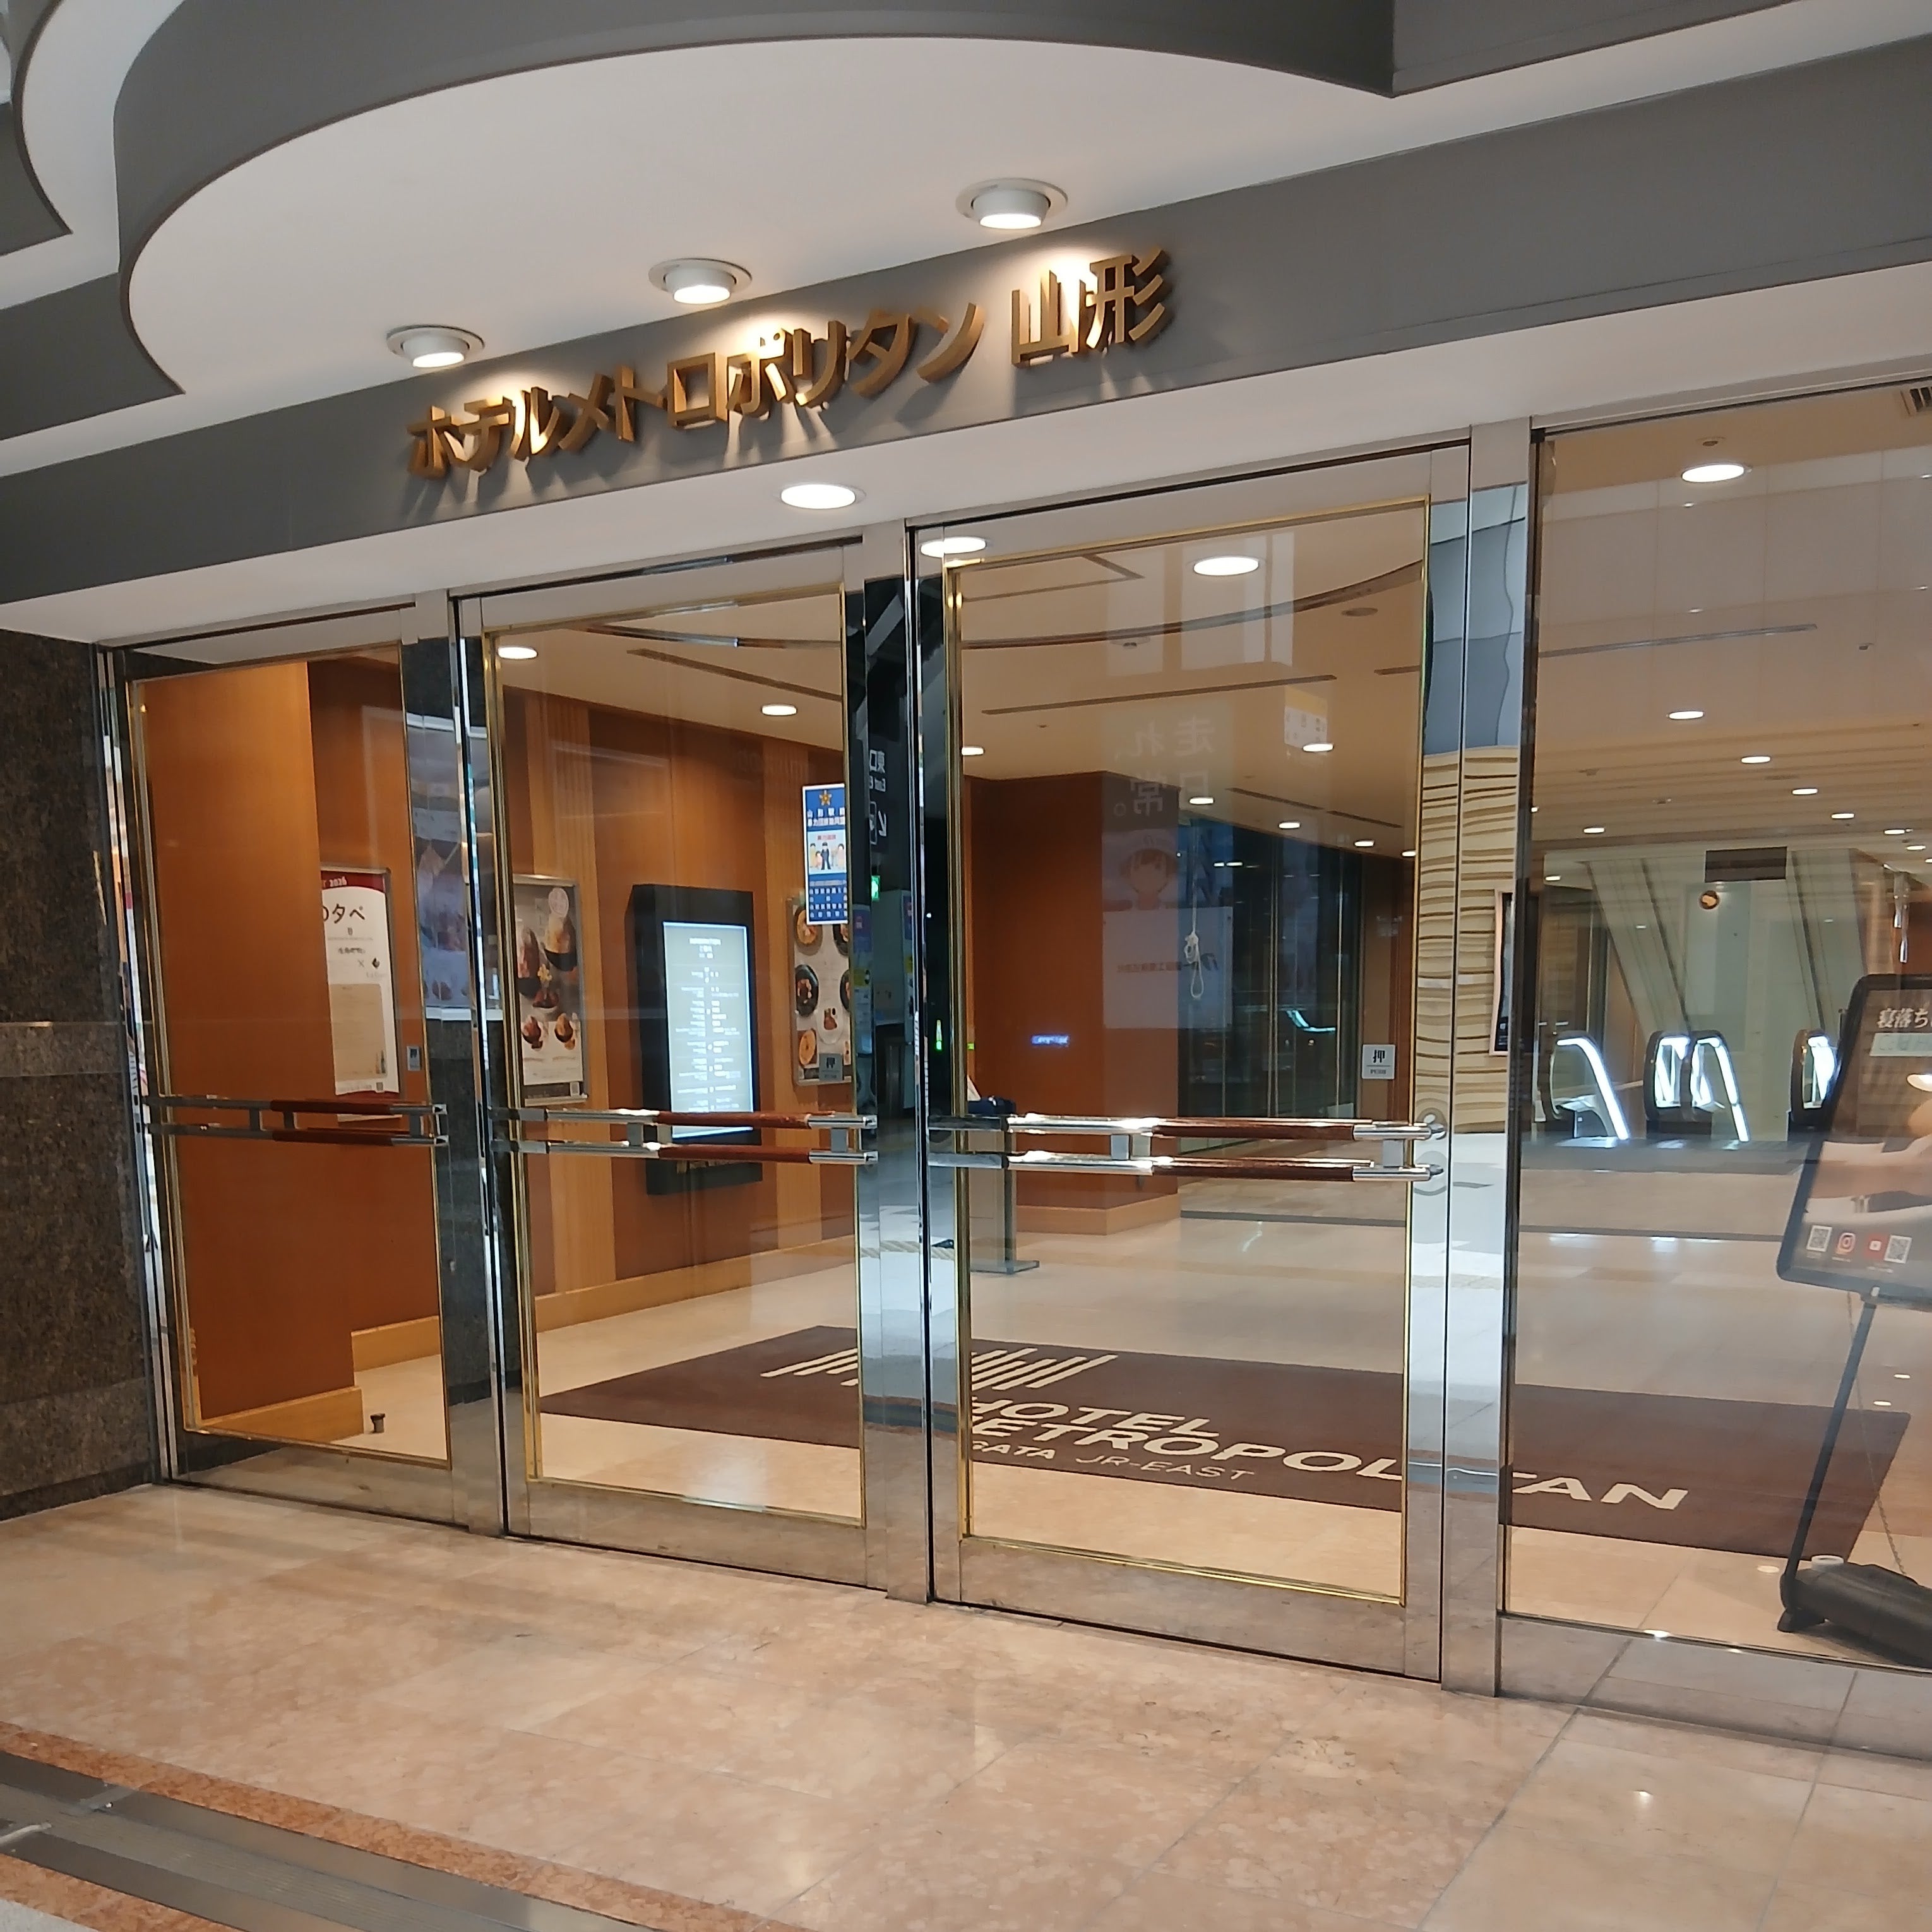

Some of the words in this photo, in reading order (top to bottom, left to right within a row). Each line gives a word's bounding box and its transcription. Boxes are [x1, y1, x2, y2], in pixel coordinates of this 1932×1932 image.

[407, 302, 984, 479] ホテルメトロポリタン
[1011, 248, 1167, 367] 山形
[1877, 1008, 1932, 1029] 寝落ち
[1075, 1455, 1256, 1481] JR-EAST
